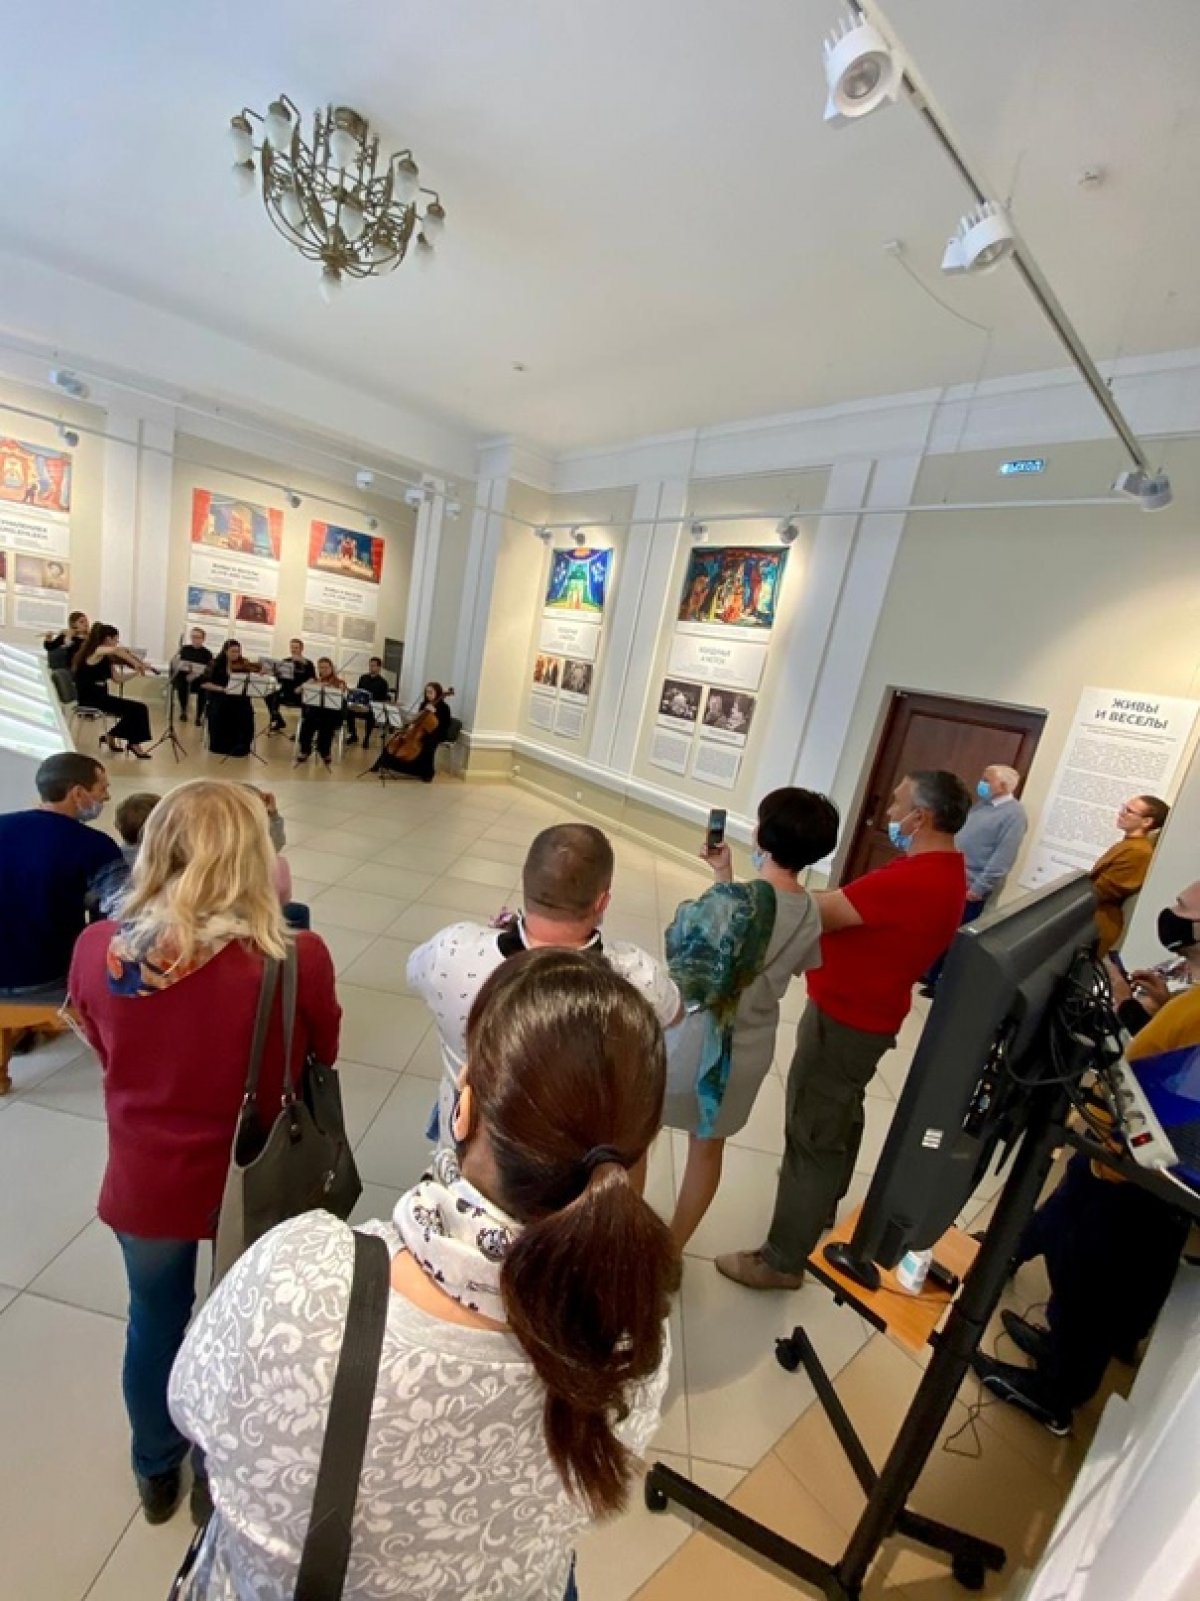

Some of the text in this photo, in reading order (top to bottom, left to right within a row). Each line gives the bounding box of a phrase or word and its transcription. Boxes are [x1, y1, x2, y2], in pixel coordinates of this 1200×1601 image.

[1111, 698, 1160, 714] ЖИВЫ
[1095, 709, 1168, 729] И ВЕСЕЛЫ
